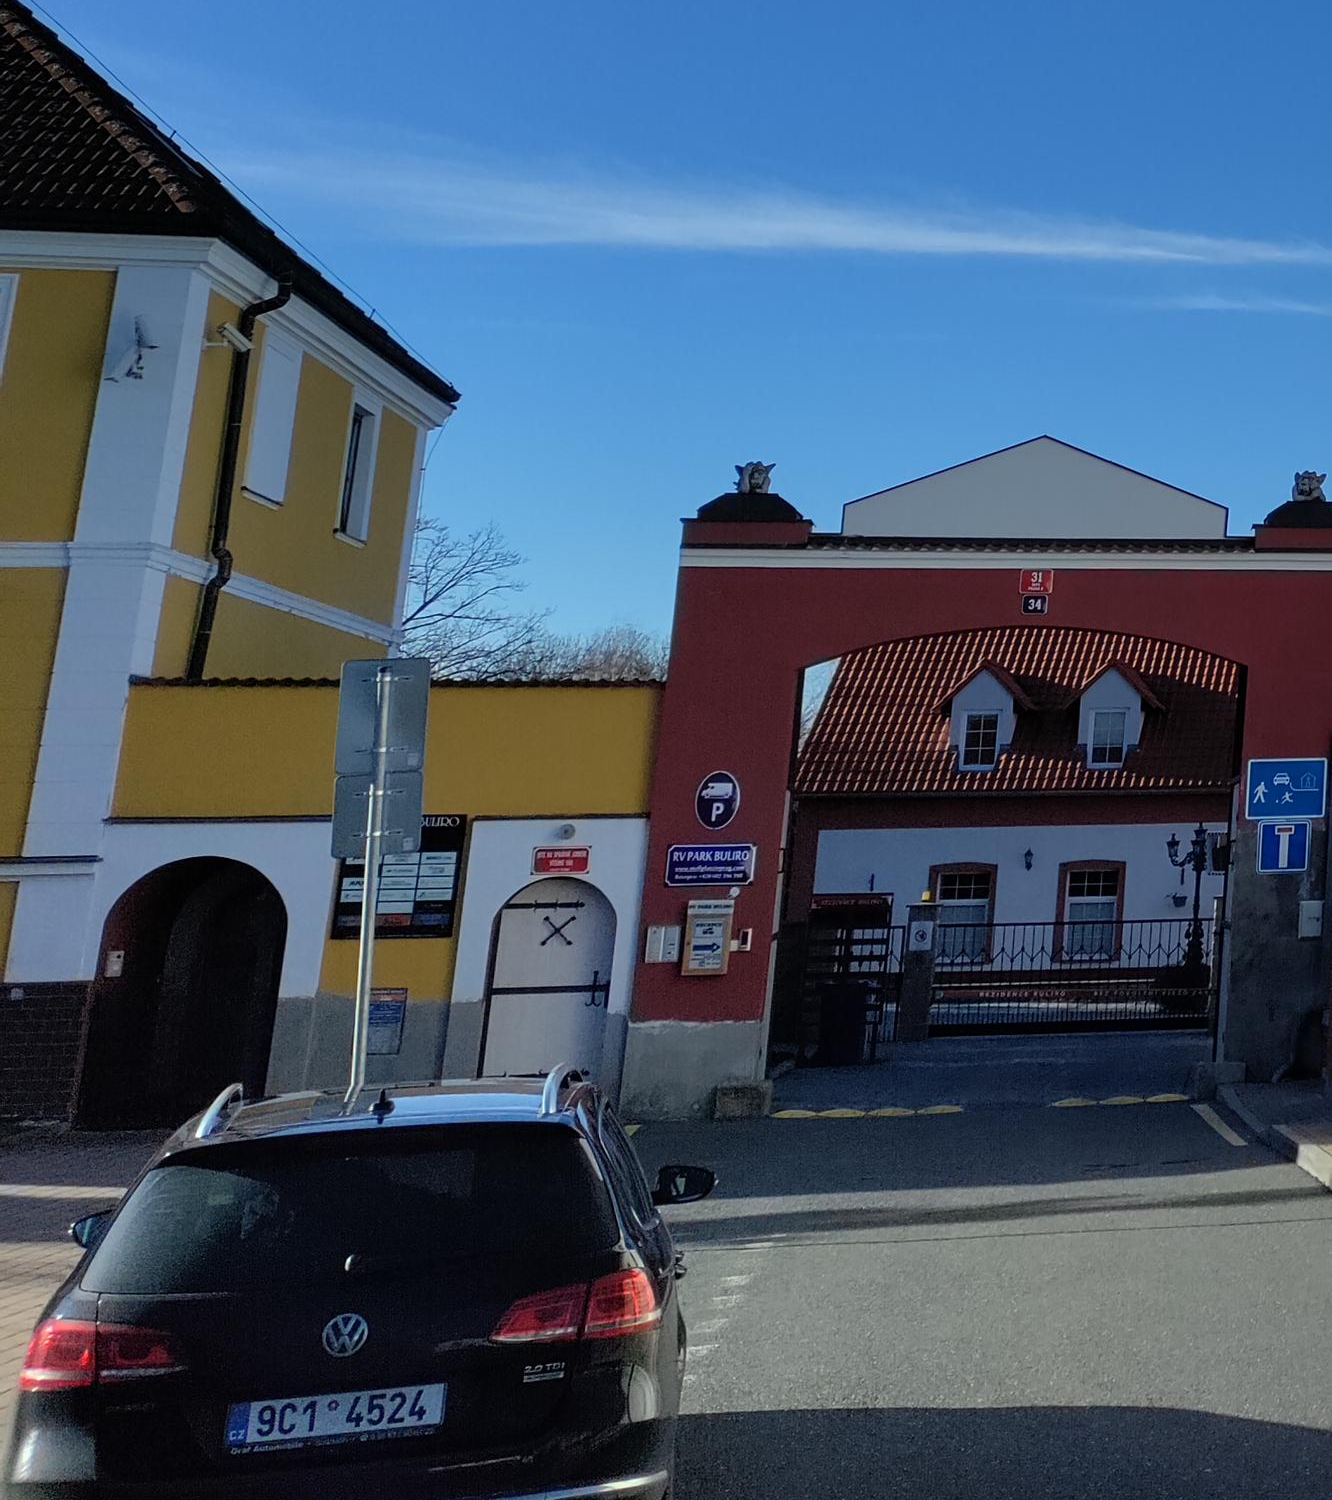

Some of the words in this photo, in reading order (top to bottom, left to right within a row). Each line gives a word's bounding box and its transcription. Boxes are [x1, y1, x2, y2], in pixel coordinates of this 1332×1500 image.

[1031, 571, 1043, 583] 31
[1027, 598, 1042, 611] 34
[711, 802, 725, 822] P
[672, 851, 687, 862] RV
[687, 850, 713, 861] PARK
[714, 850, 750, 861] BULIRO
[545, 1361, 566, 1371] TDI
[256, 1400, 318, 1438] 9C1
[345, 1389, 427, 1428] 4524
[228, 1428, 246, 1442] CZ
